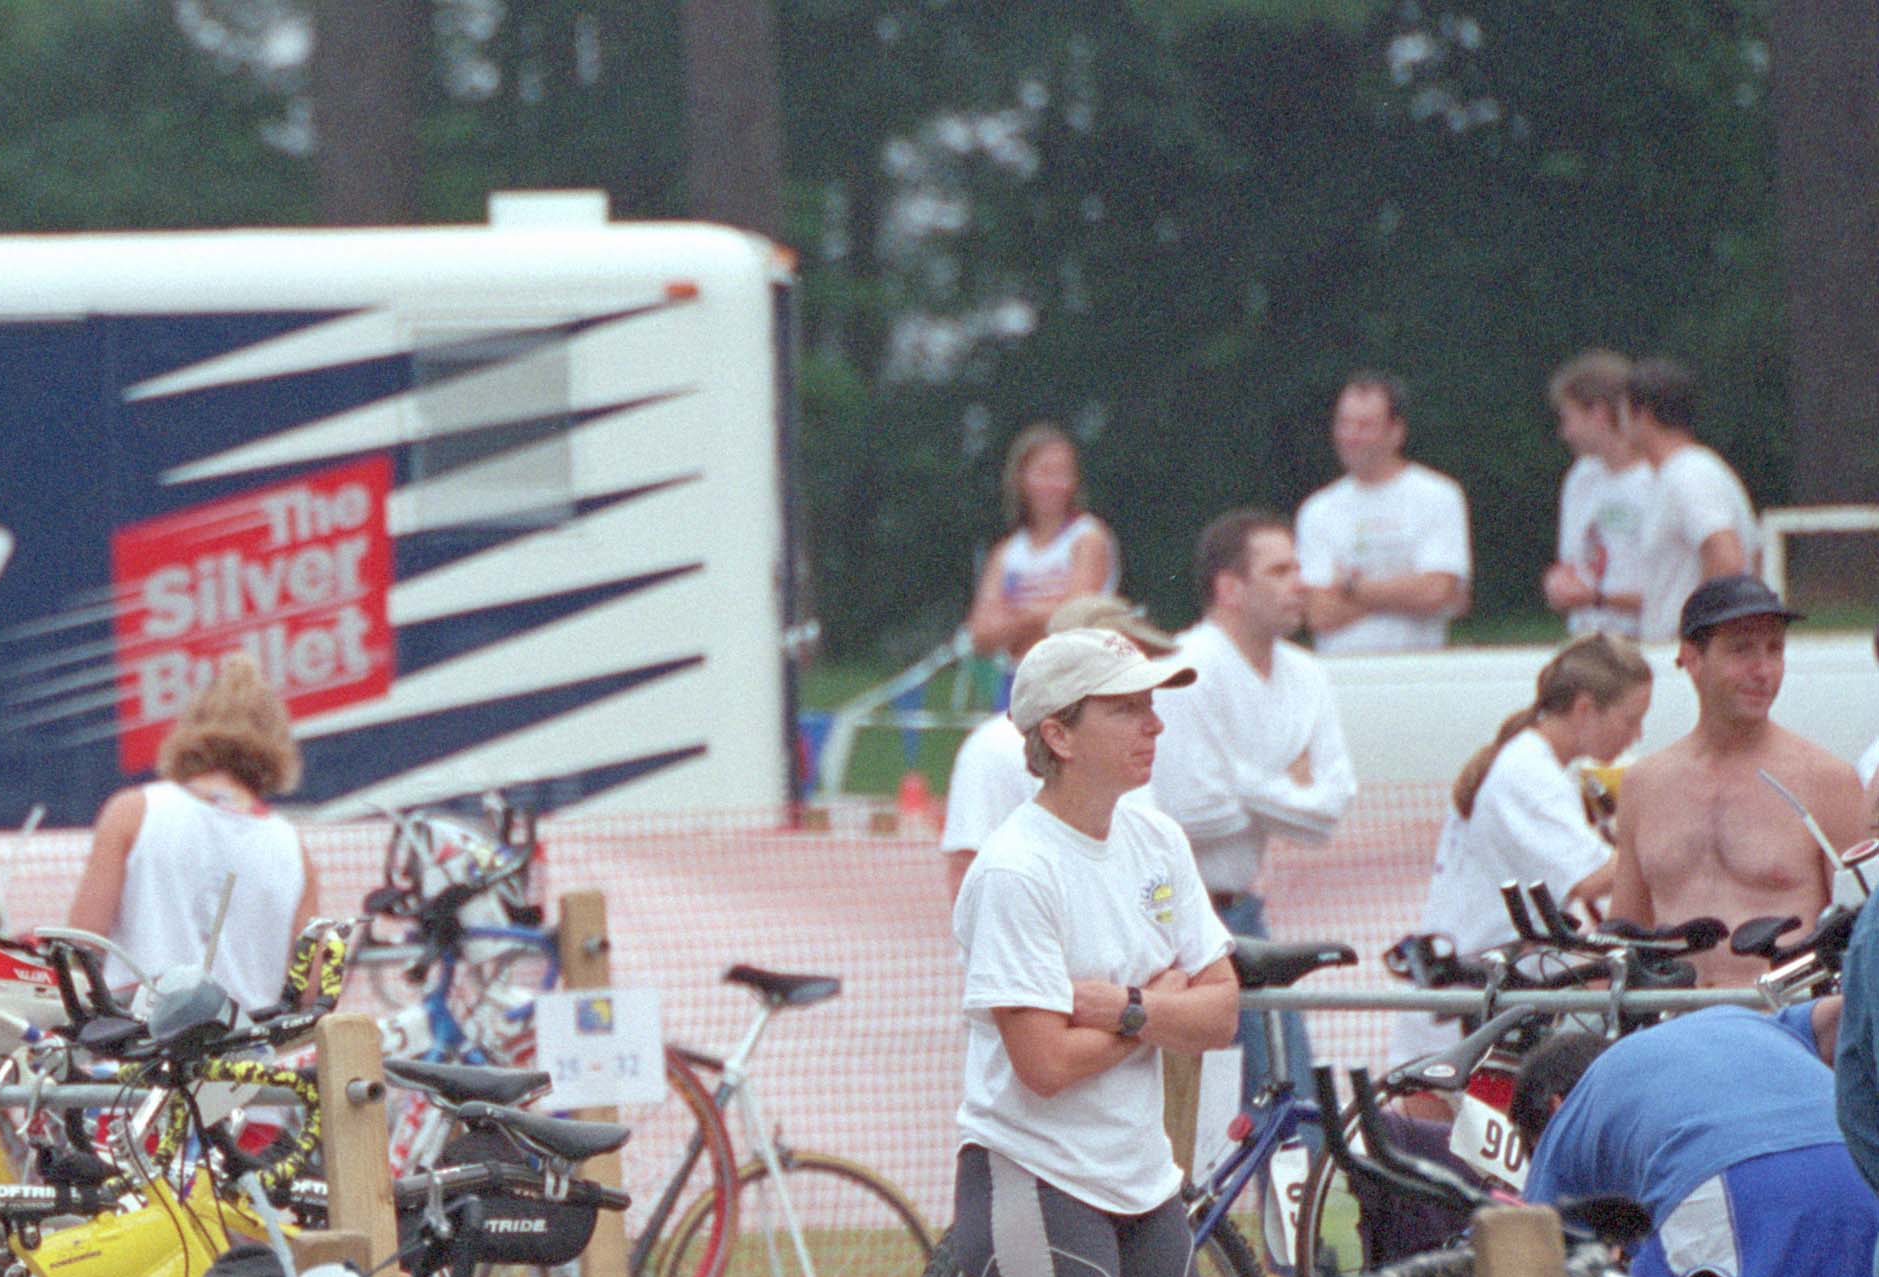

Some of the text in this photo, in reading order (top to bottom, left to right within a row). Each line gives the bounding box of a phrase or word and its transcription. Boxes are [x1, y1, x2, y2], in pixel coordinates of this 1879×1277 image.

[262, 481, 369, 547] The
[142, 537, 369, 638] Silver
[1479, 1118, 1524, 1173] 90
